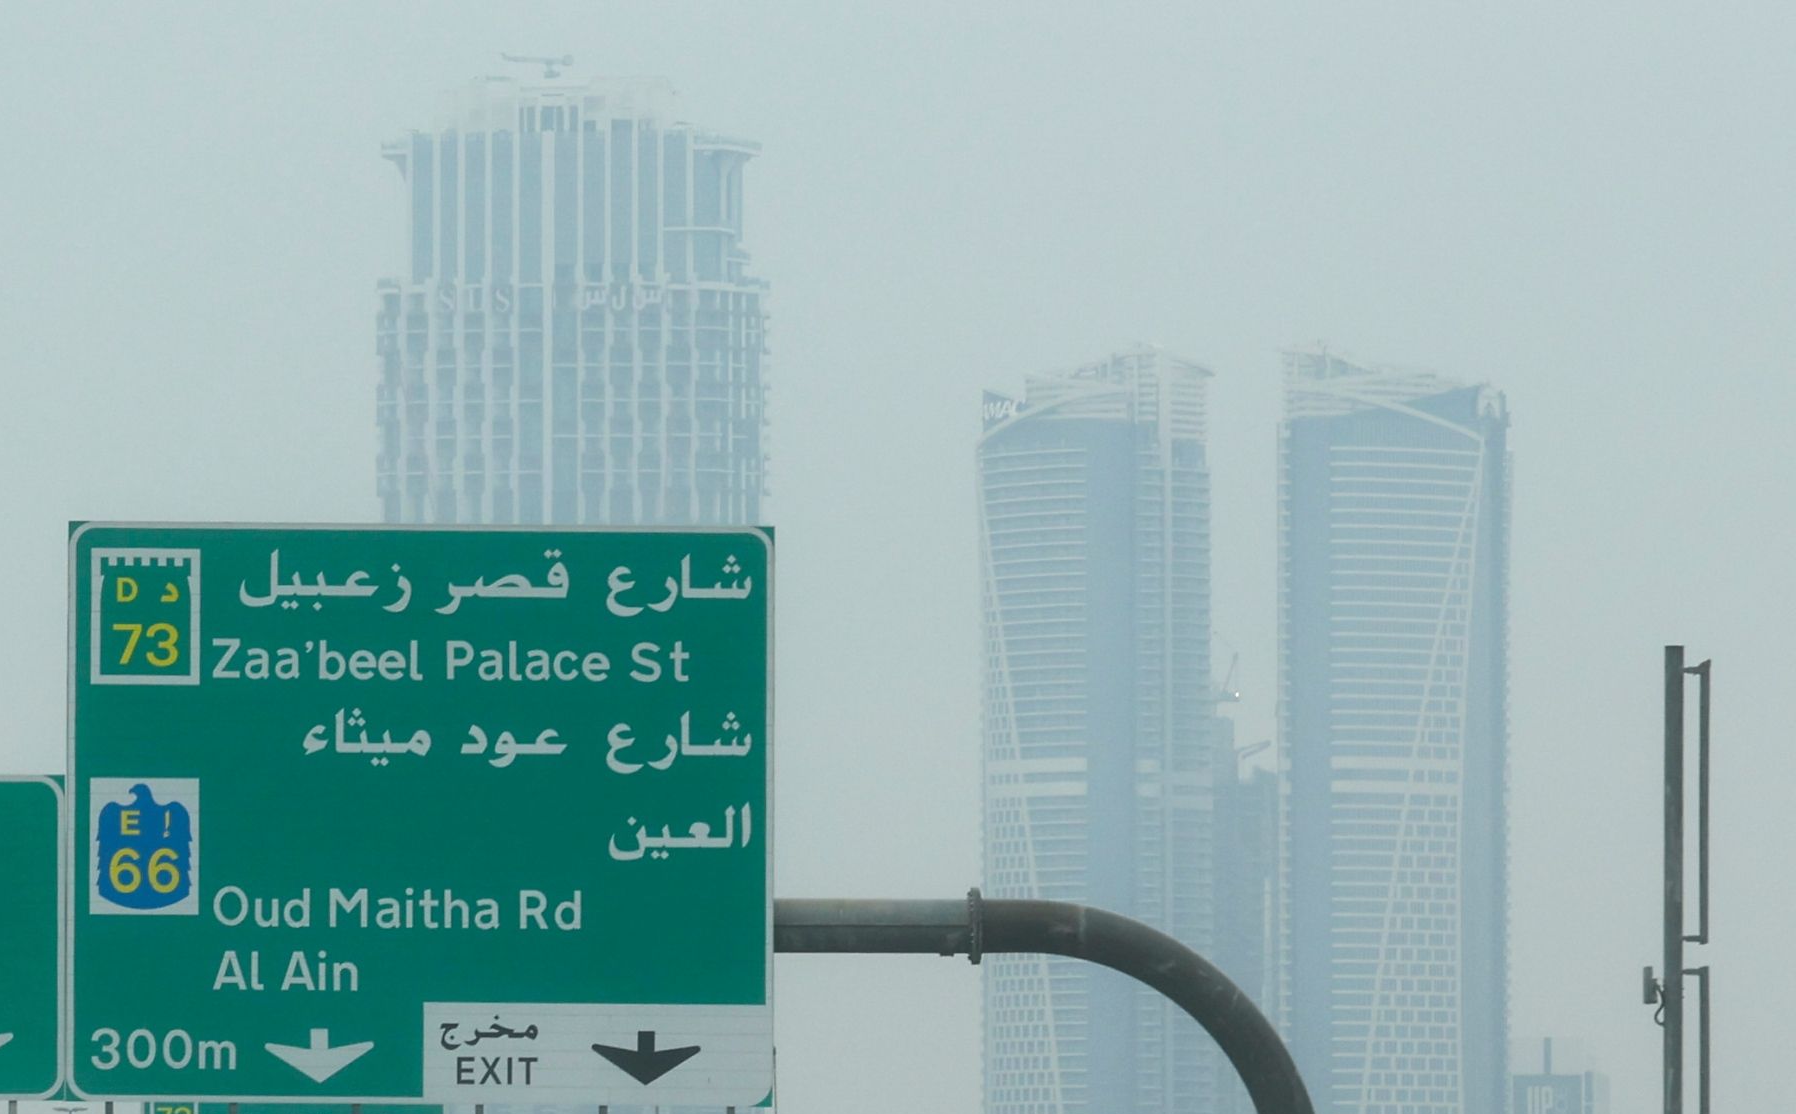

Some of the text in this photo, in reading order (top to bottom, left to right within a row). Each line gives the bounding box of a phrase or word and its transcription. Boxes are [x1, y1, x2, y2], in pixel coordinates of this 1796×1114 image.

[116, 578, 138, 601] D
[239, 549, 752, 617] شارع قصر زعبيل
[112, 624, 179, 667] 73
[212, 638, 690, 682] Zaa'beel Palace St
[304, 708, 752, 773] شارع عود ميثاء
[120, 811, 140, 834] E
[608, 802, 751, 860] العين
[109, 848, 179, 893] 66
[213, 886, 582, 931] Oud Maitha Rd
[213, 950, 358, 991] Al Ain
[90, 1028, 237, 1070] 300m
[440, 1015, 538, 1050] مخرج
[456, 1057, 537, 1085] EXIT
